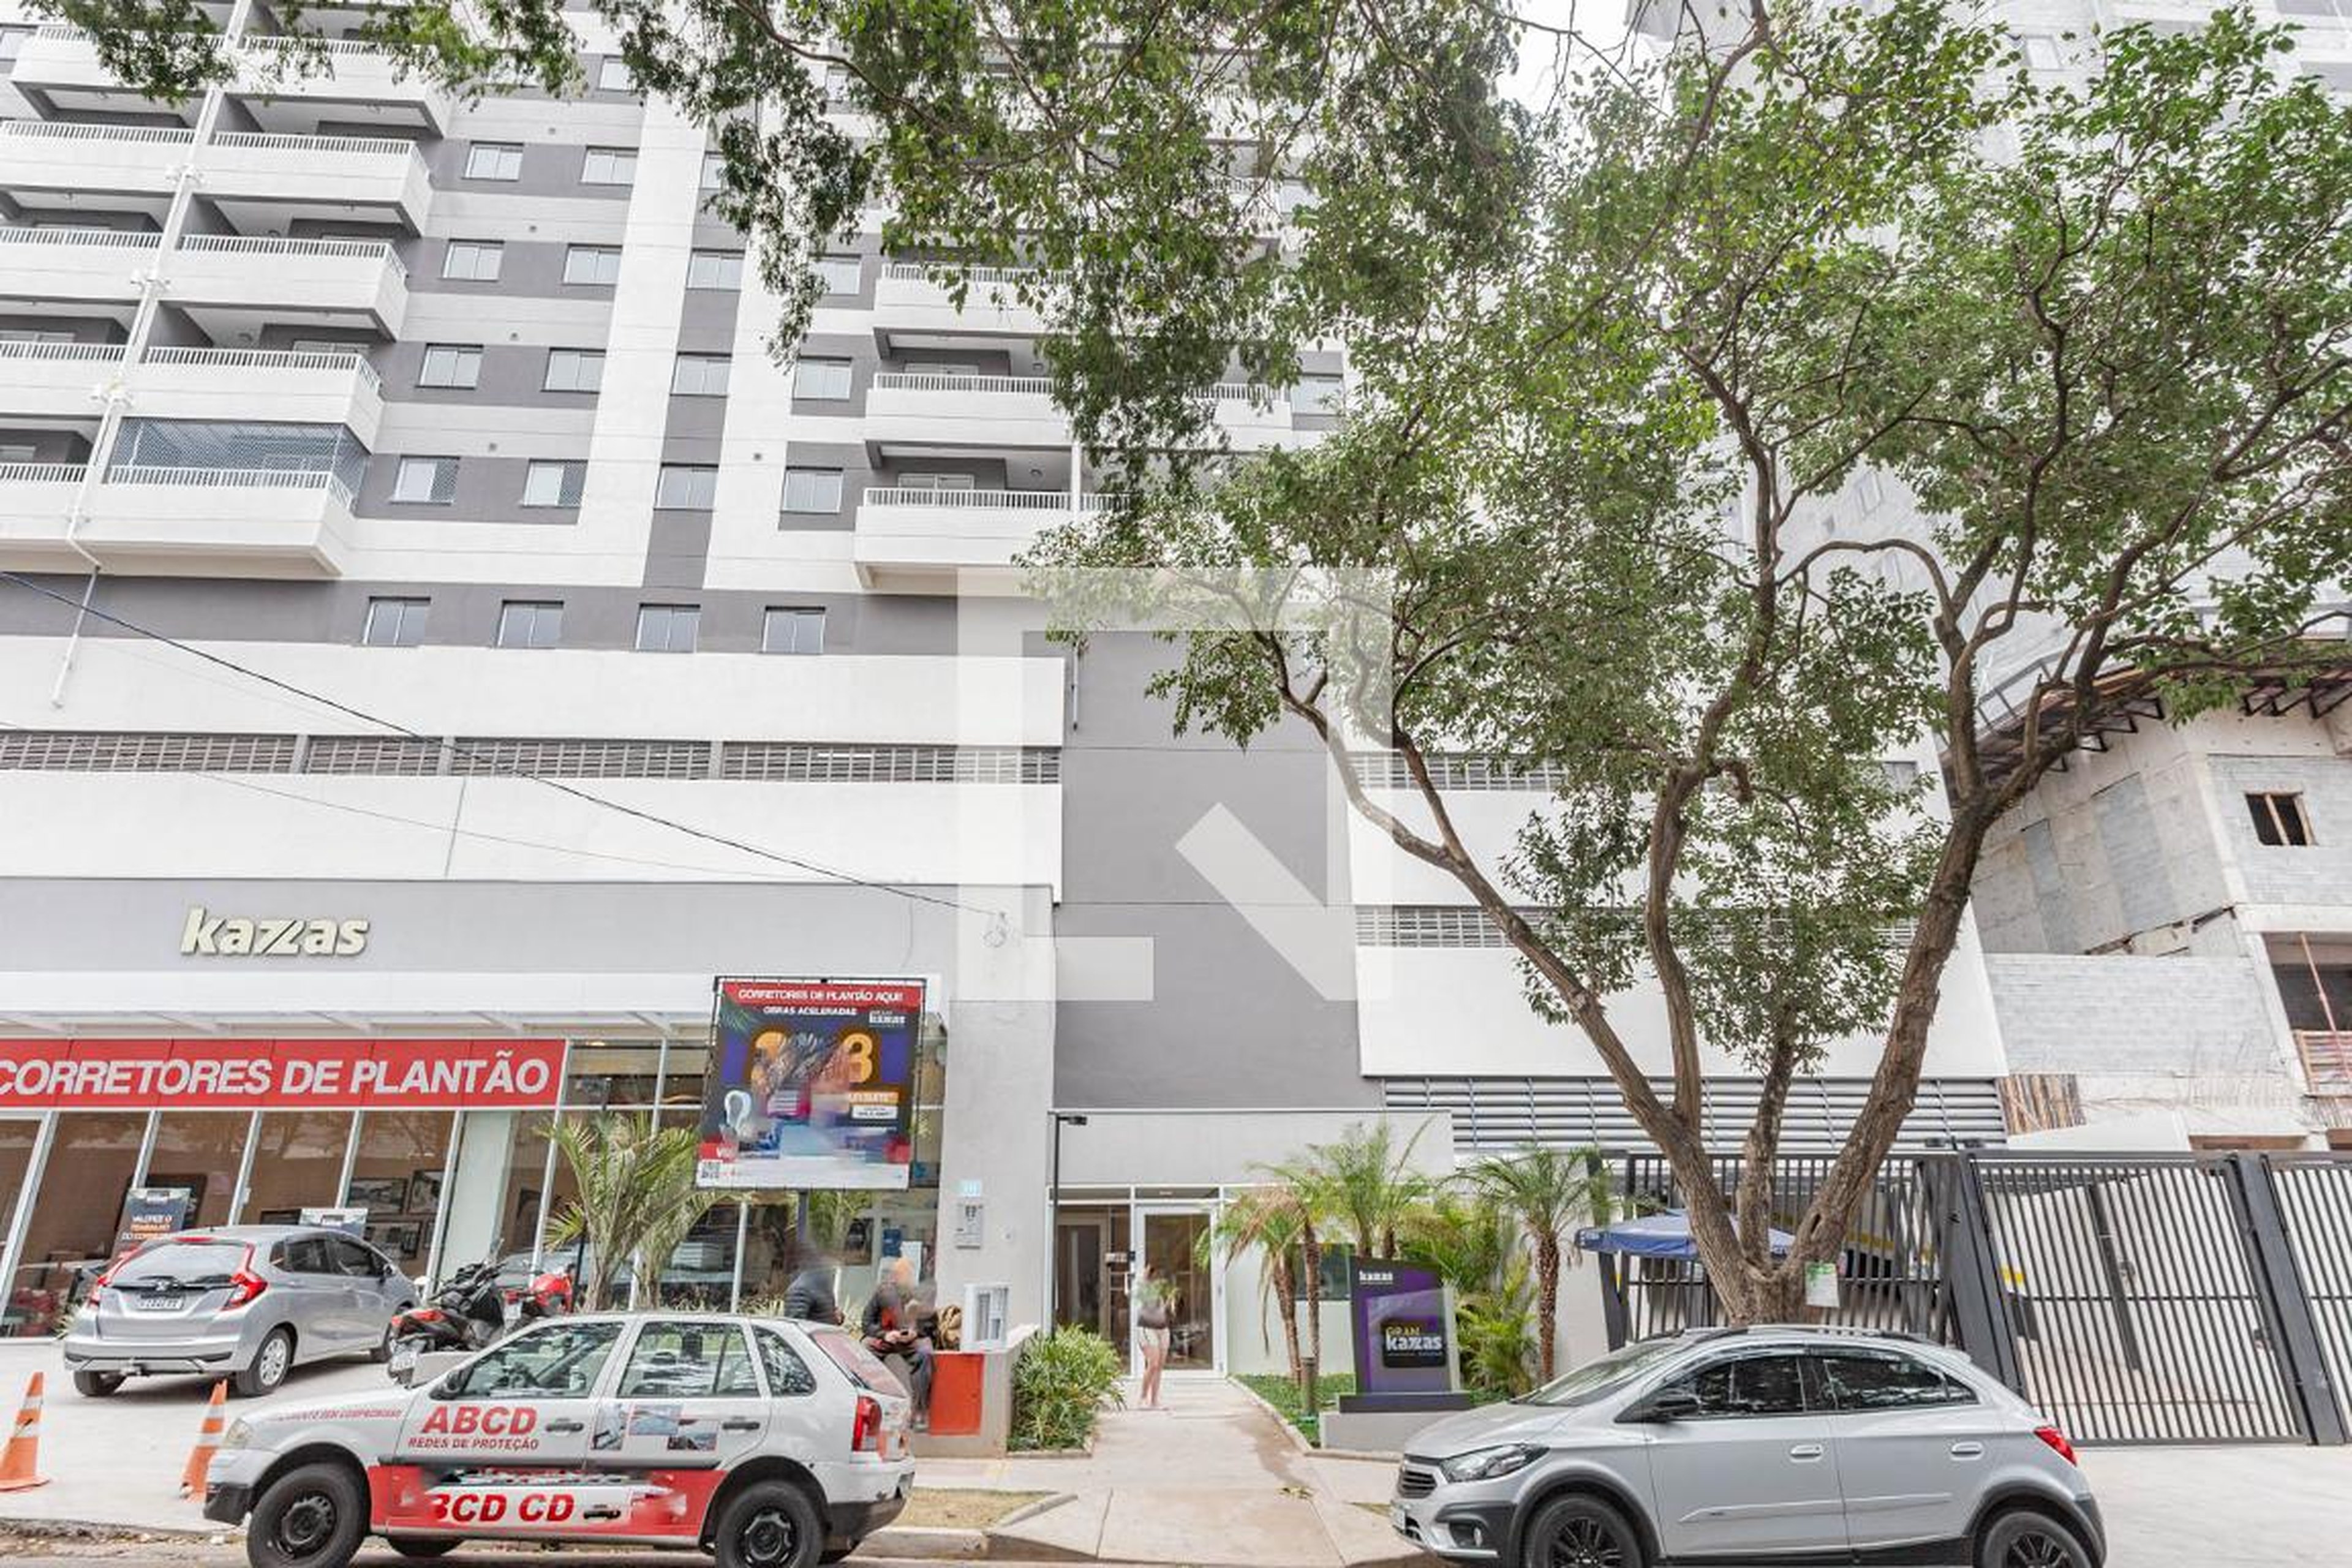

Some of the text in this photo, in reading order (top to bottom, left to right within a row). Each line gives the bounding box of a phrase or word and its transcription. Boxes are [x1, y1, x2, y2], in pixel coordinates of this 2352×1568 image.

[738, 989, 808, 1000] CORRETORES
[810, 990, 824, 1000] DE
[763, 1006, 796, 1016] OBRAS
[0, 1049, 550, 1095] CORRETORES DE PLANTÃO
[1386, 1327, 1420, 1336] GRAN
[421, 1406, 537, 1435] ABCD
[408, 1436, 540, 1454] REDES DE PROTEÇÃO
[518, 1494, 575, 1522] CD
